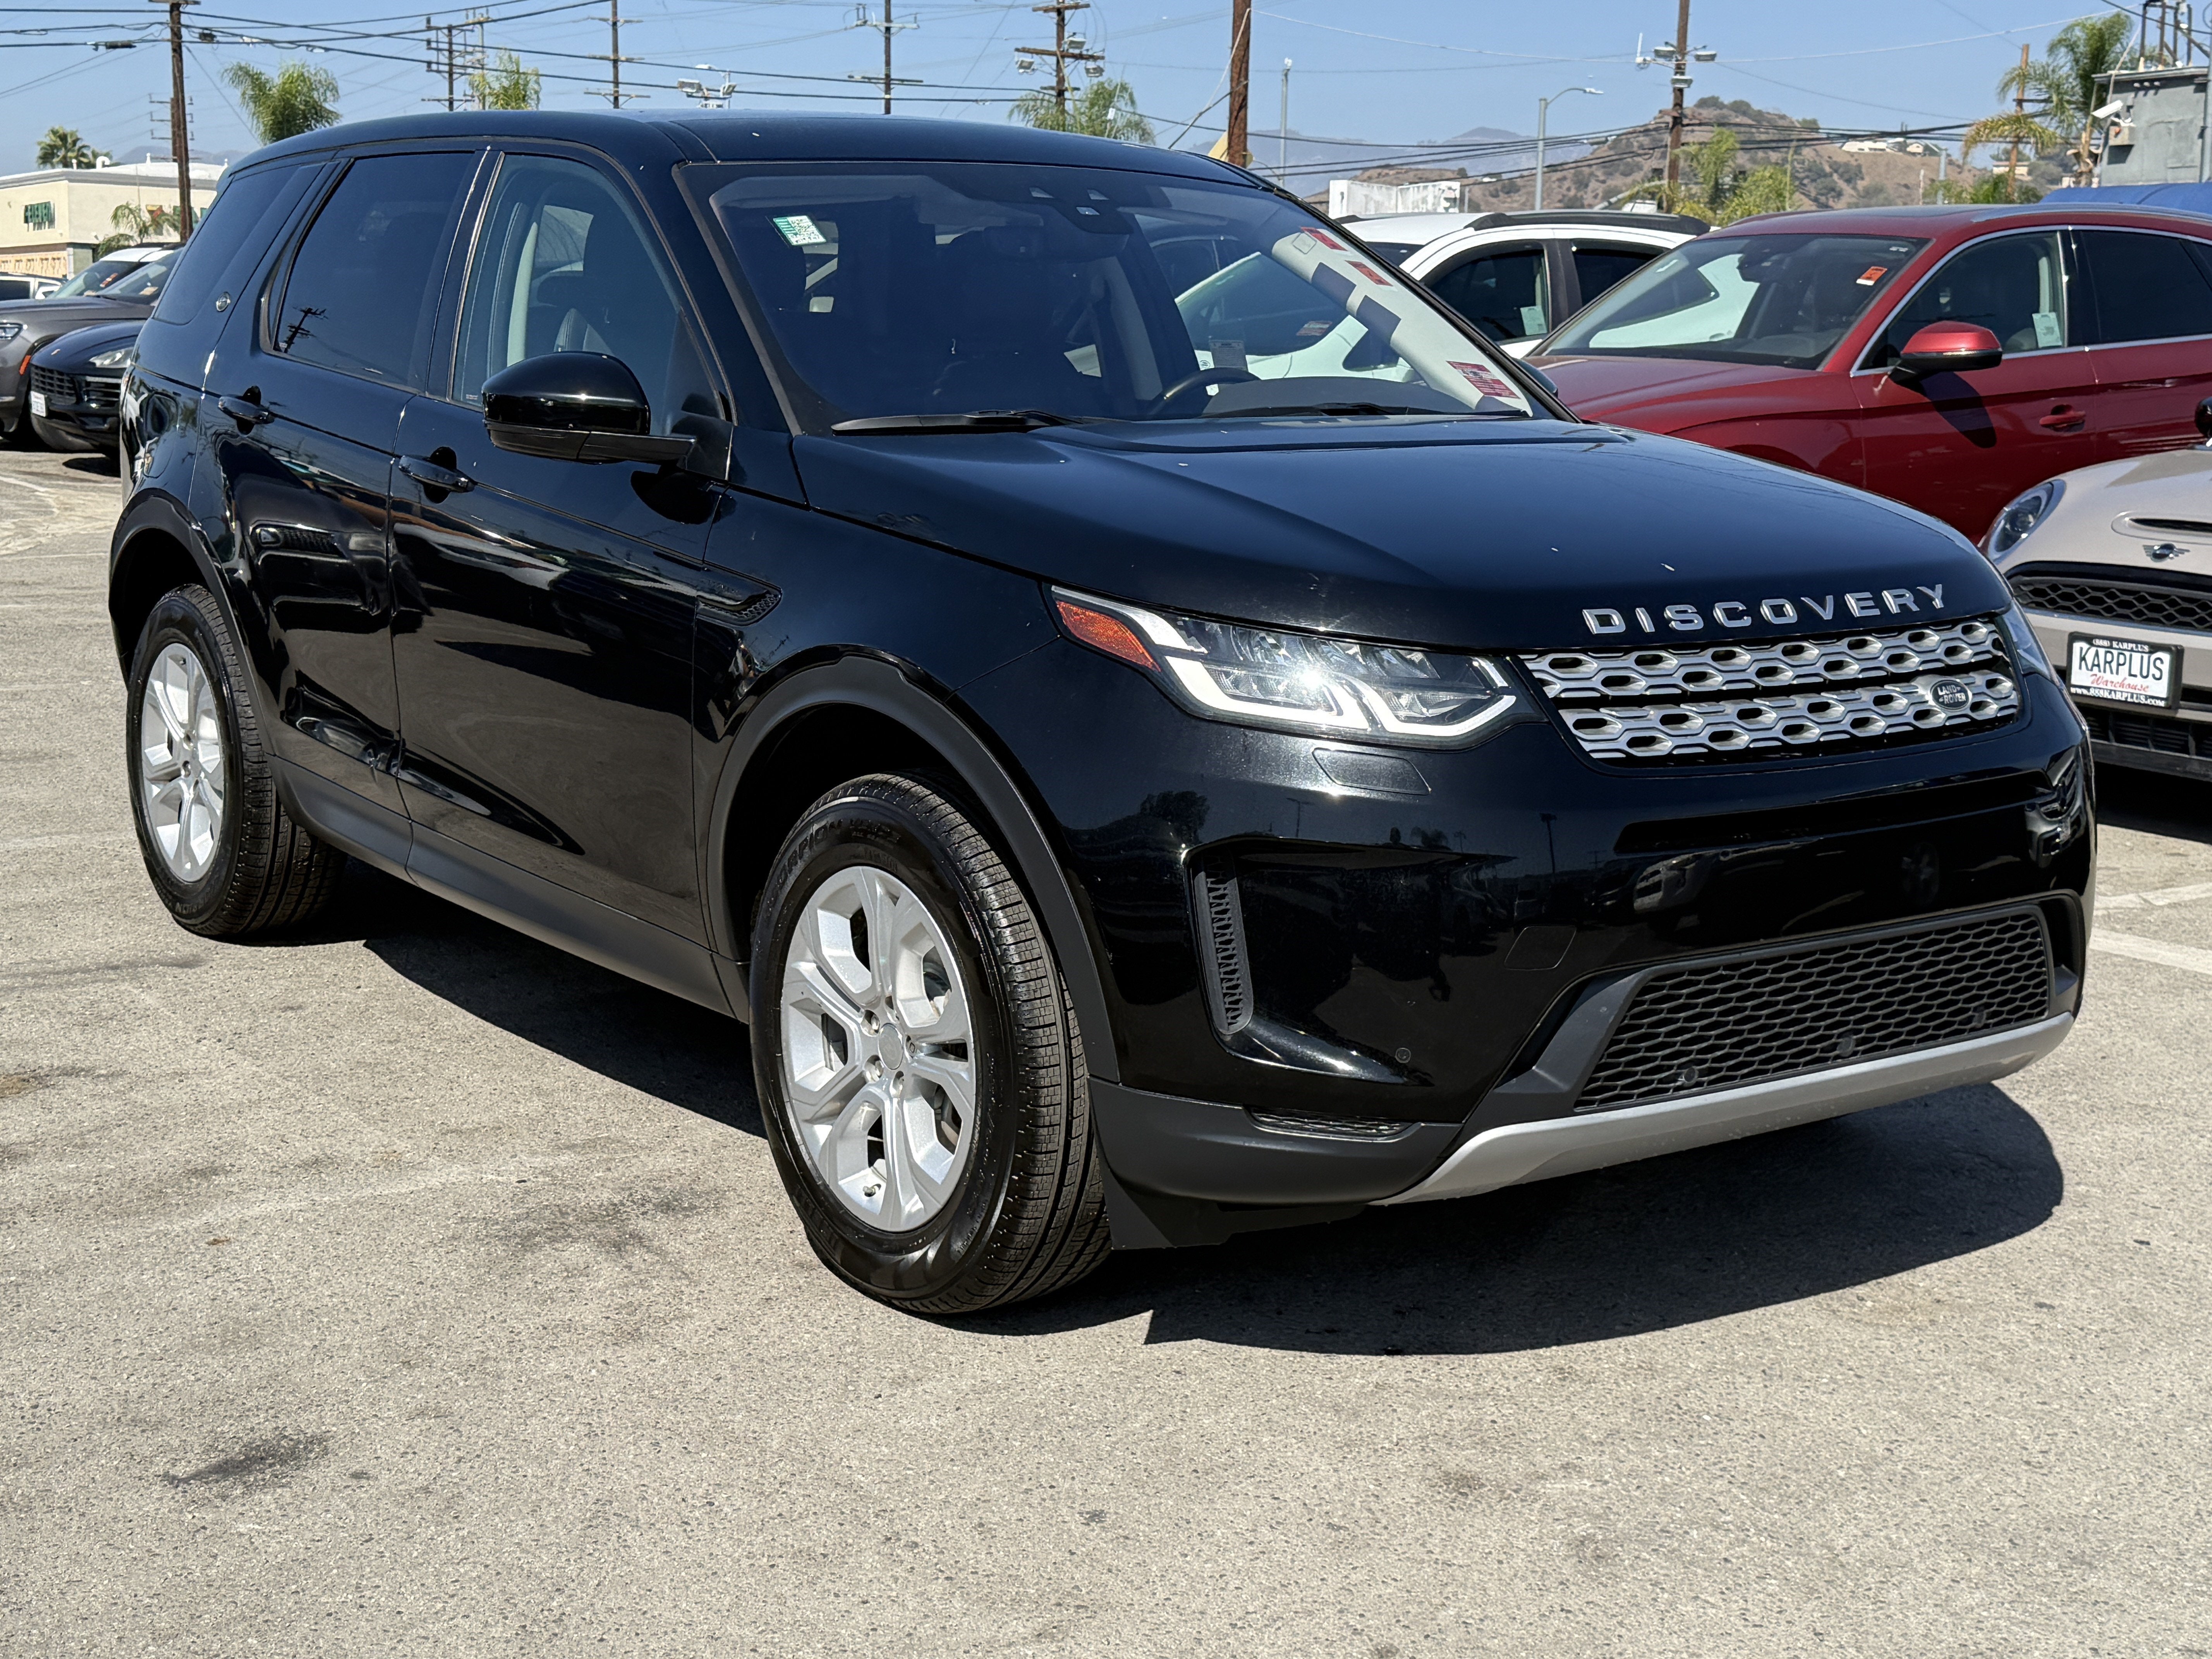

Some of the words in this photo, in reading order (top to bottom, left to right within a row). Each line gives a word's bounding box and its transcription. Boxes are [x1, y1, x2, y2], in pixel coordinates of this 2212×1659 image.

[1583, 584, 1944, 634] DISCOVERY
[2112, 641, 2149, 652] KARPLUS
[2078, 646, 2164, 681] KARPLUS
[1937, 685, 1957, 696] LAND
[2090, 673, 2149, 693] Warehouse
[1944, 692, 1966, 704] ROVER
